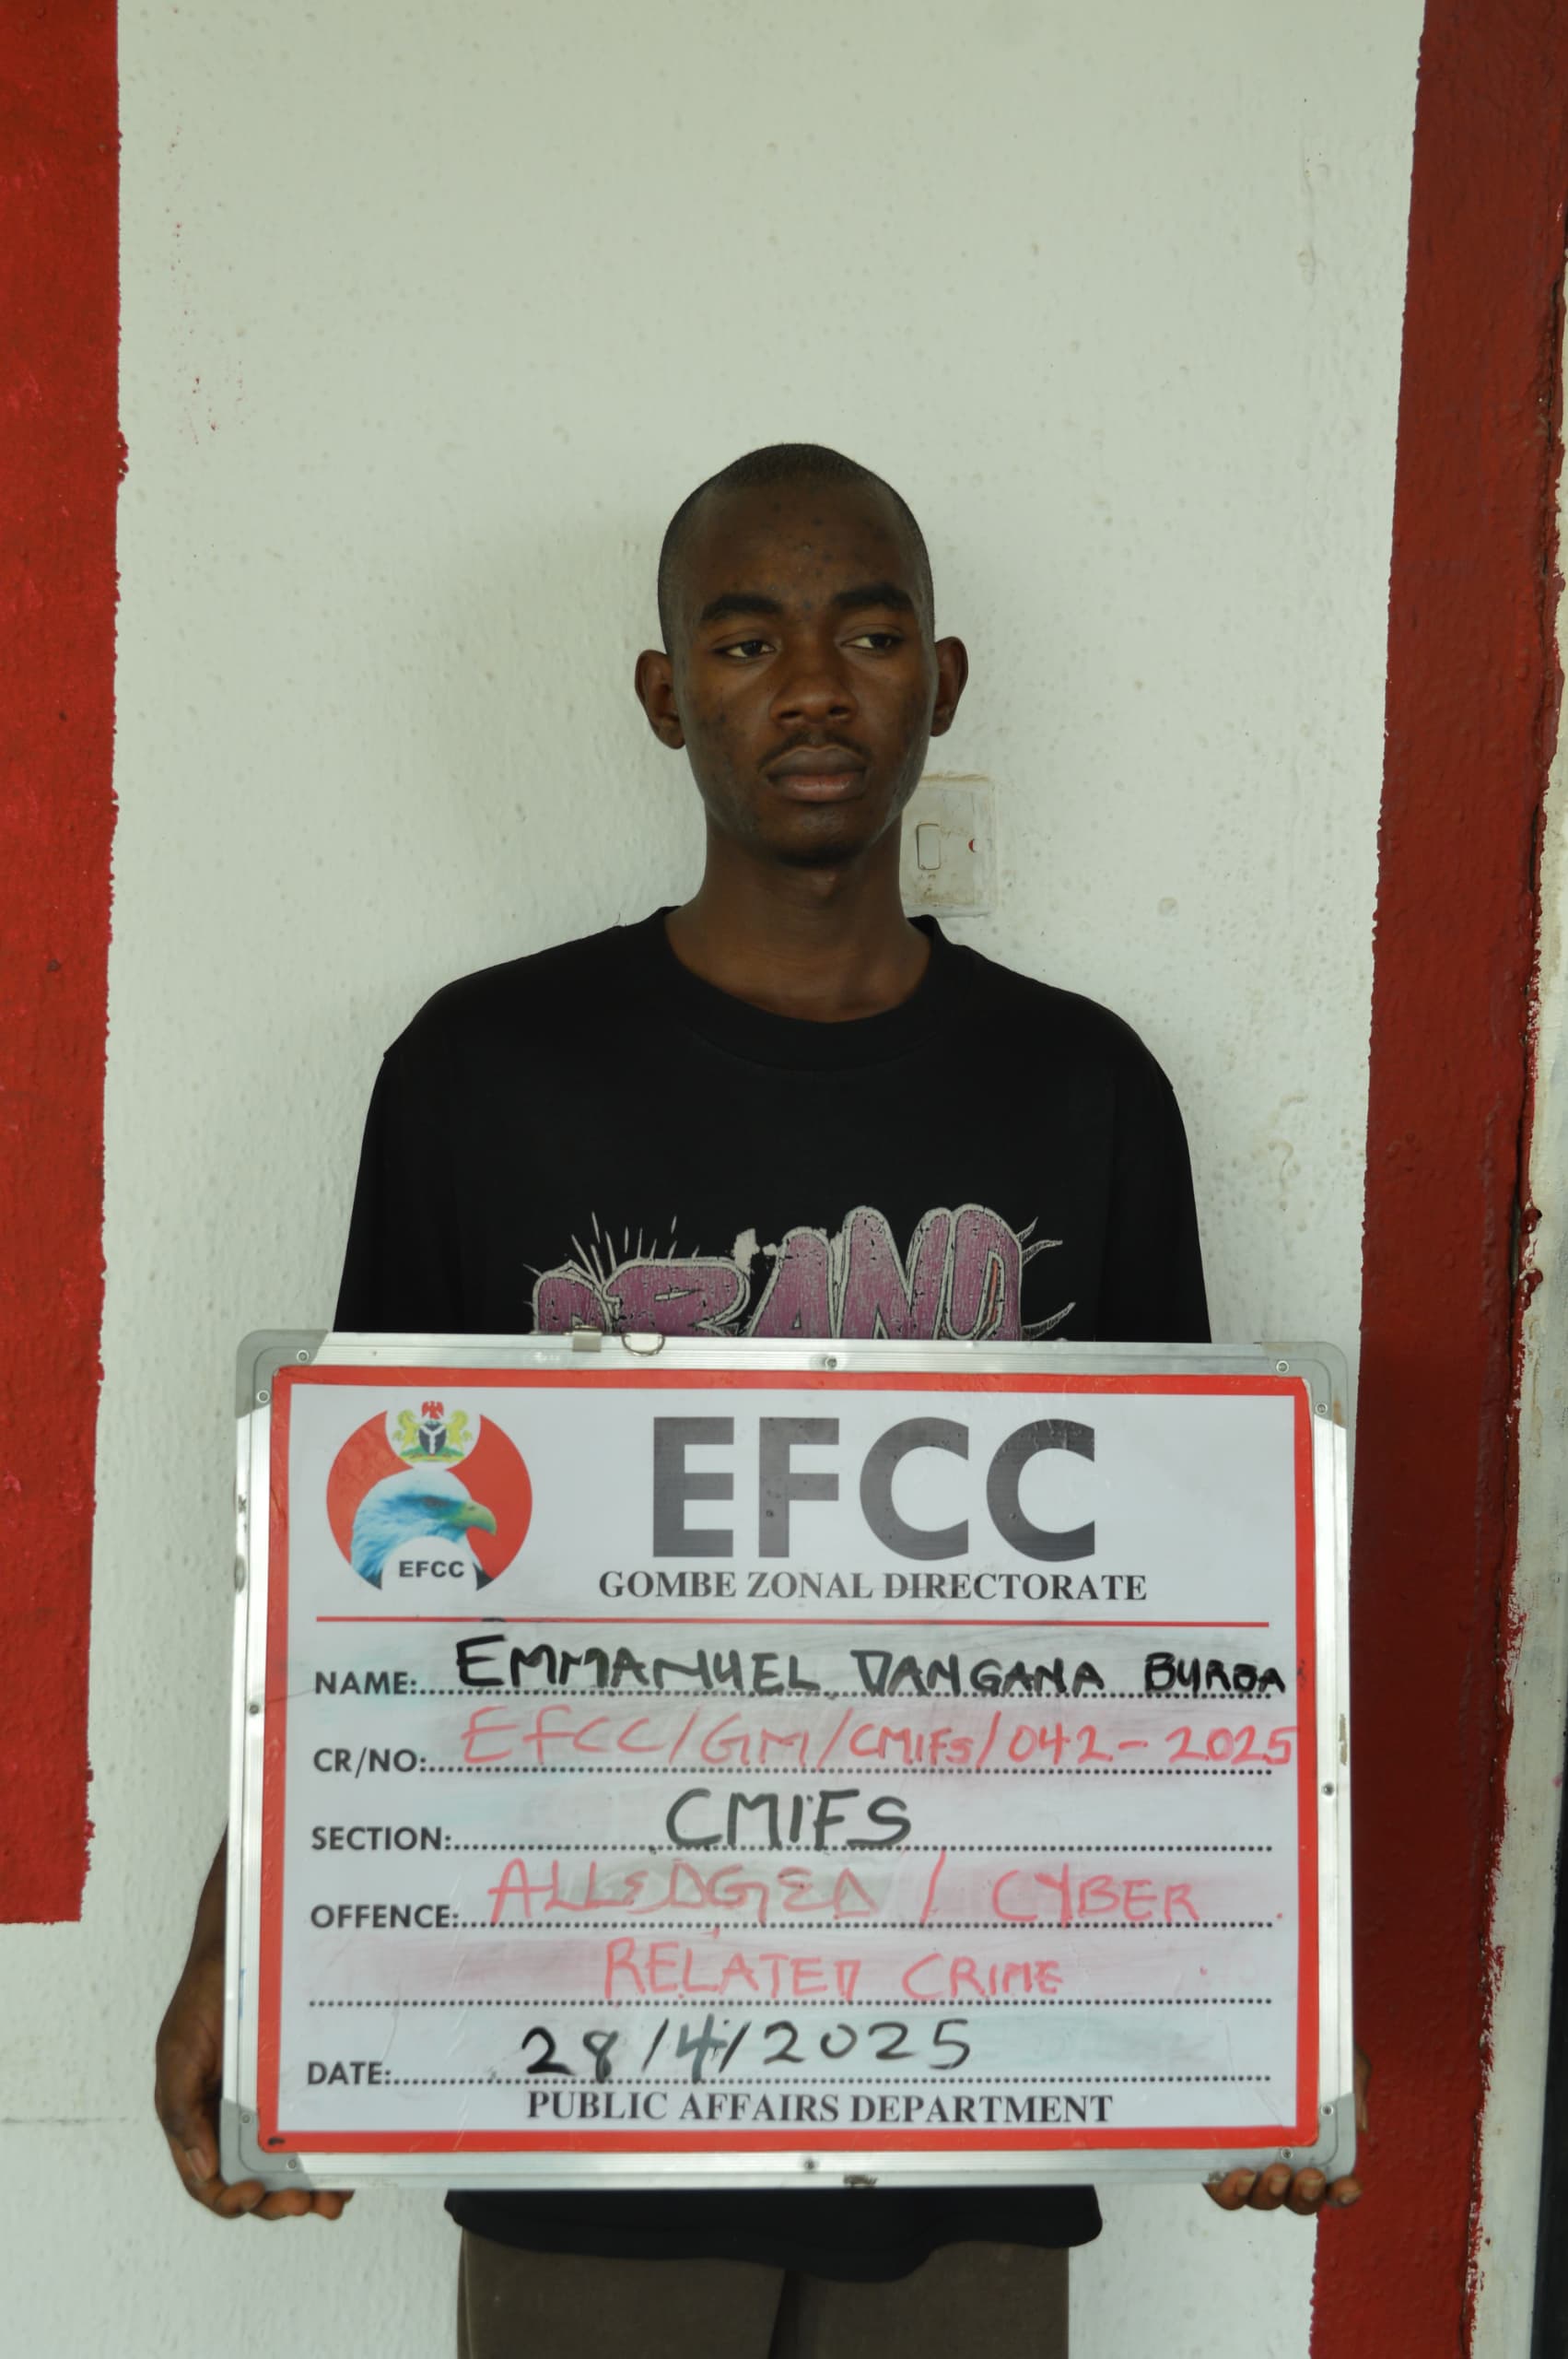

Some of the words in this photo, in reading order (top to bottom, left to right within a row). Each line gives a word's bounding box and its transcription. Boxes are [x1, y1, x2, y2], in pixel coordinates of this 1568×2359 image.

[652, 1415, 1096, 1563] EFCC
[399, 1560, 466, 1579] EFCC
[599, 1571, 738, 1599] GOMBE
[746, 1571, 874, 1601] ZONAL
[882, 1573, 1148, 1602] DIRECTORATE
[456, 1634, 821, 1696] EMMANUEL
[849, 1648, 1106, 1696] DANGANA
[315, 1671, 418, 1695] NAME:
[312, 1748, 427, 1778] CR/NO:
[665, 1787, 912, 1850] CMIFS
[310, 1826, 451, 1851] SECTION:
[991, 1863, 1199, 1928] CYBER
[310, 1904, 459, 1929] OFFENCE:
[902, 1952, 1063, 2001] CRIME
[307, 2060, 392, 2086] DATE:
[527, 2091, 667, 2119] PUBLIC
[678, 2092, 839, 2121] AFFAIRS
[848, 2095, 1113, 2123] DEPARTMENT
